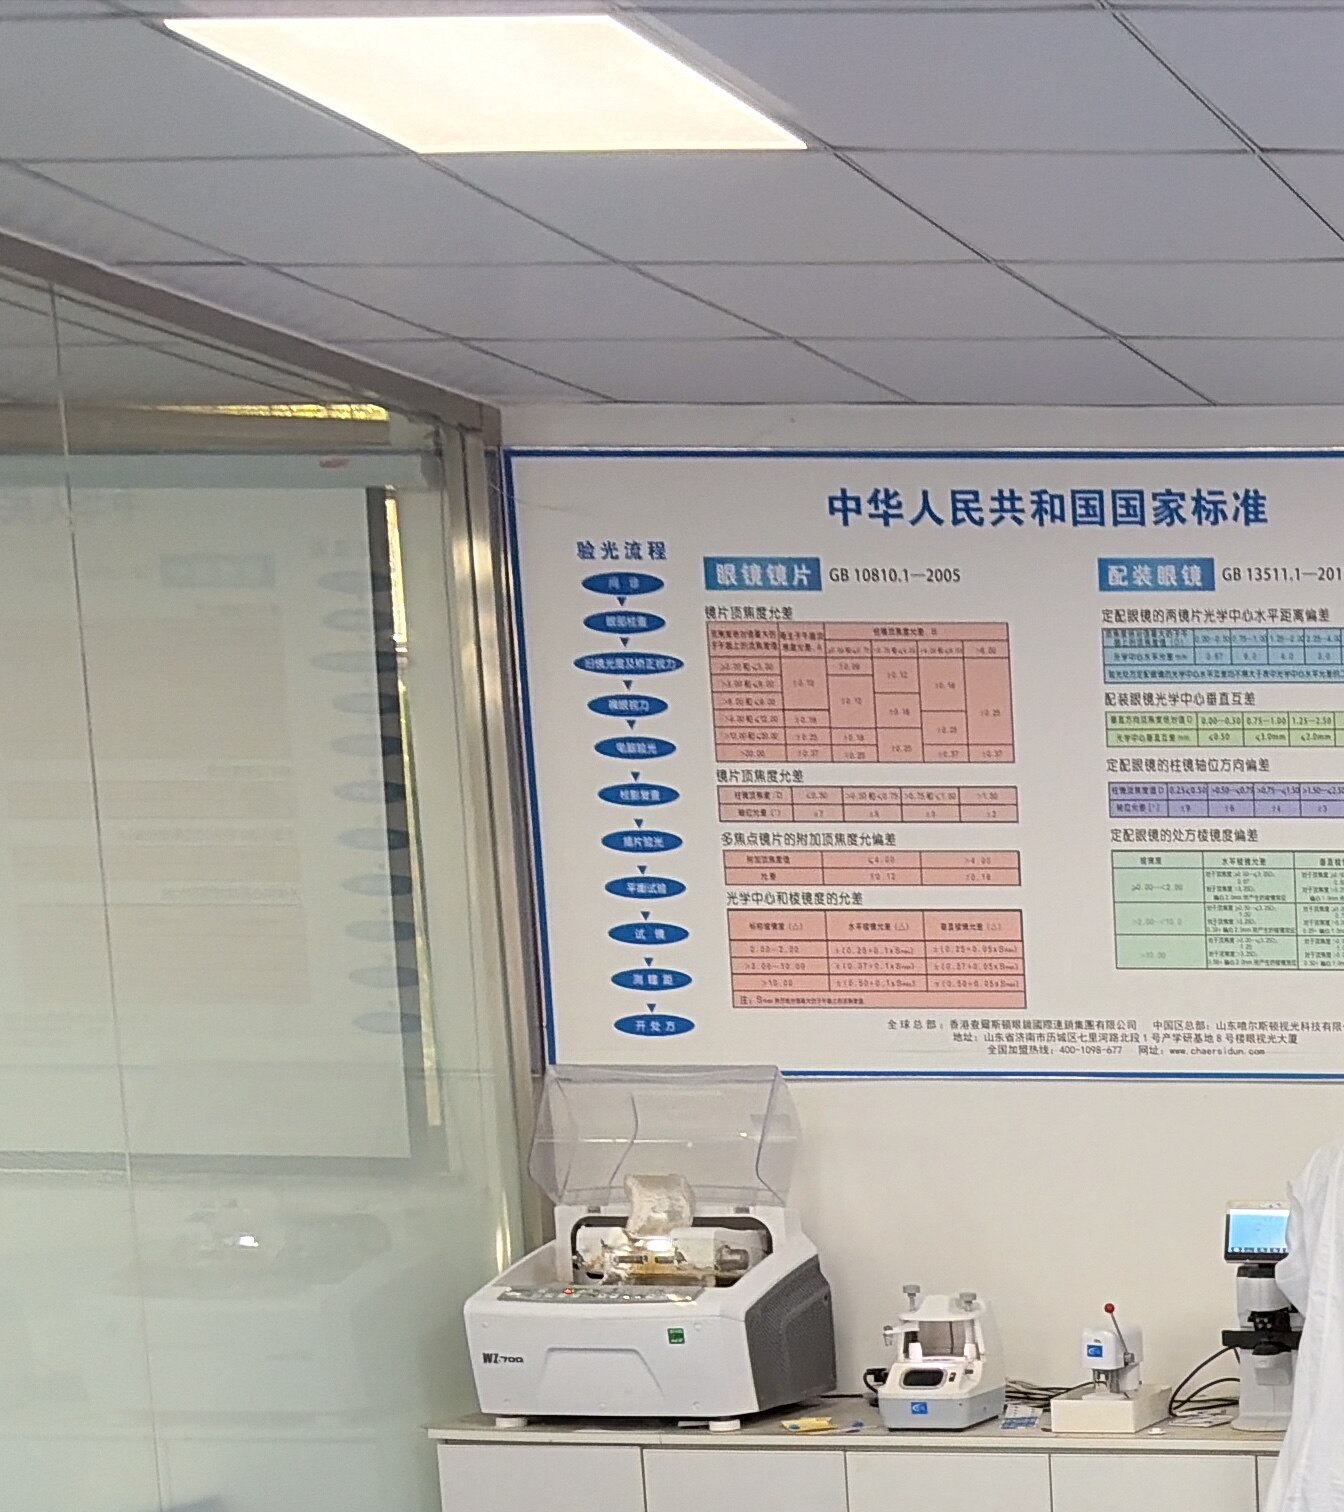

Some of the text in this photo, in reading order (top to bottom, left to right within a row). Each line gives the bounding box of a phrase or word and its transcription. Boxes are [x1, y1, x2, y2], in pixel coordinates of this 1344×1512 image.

[827, 487, 1269, 528] 中华人民共和国国家标准
[576, 540, 668, 561] 验光流程
[715, 562, 812, 587] 眼镜镜片
[829, 567, 850, 584] GB
[1106, 563, 1203, 587] 配装眼镜
[1222, 566, 1242, 582] GB
[704, 605, 793, 621] 镜片顶焦度允差
[1101, 607, 1331, 624] 定配眼镜的两镜片光学中心水平距离偏差
[1104, 691, 1256, 707] 配装眼镜光学中心垂直互差
[1106, 758, 1270, 773] 定配眼镜的柱镜轴位方向偏差
[716, 768, 804, 783] 镜片顶焦度允差
[1110, 828, 1259, 843] 定配眼镜的处方棱镜度偏差
[726, 891, 864, 906] 光学中心和棱镜度的允差
[634, 928, 666, 940] 试镜
[634, 1020, 677, 1032] 开处方
